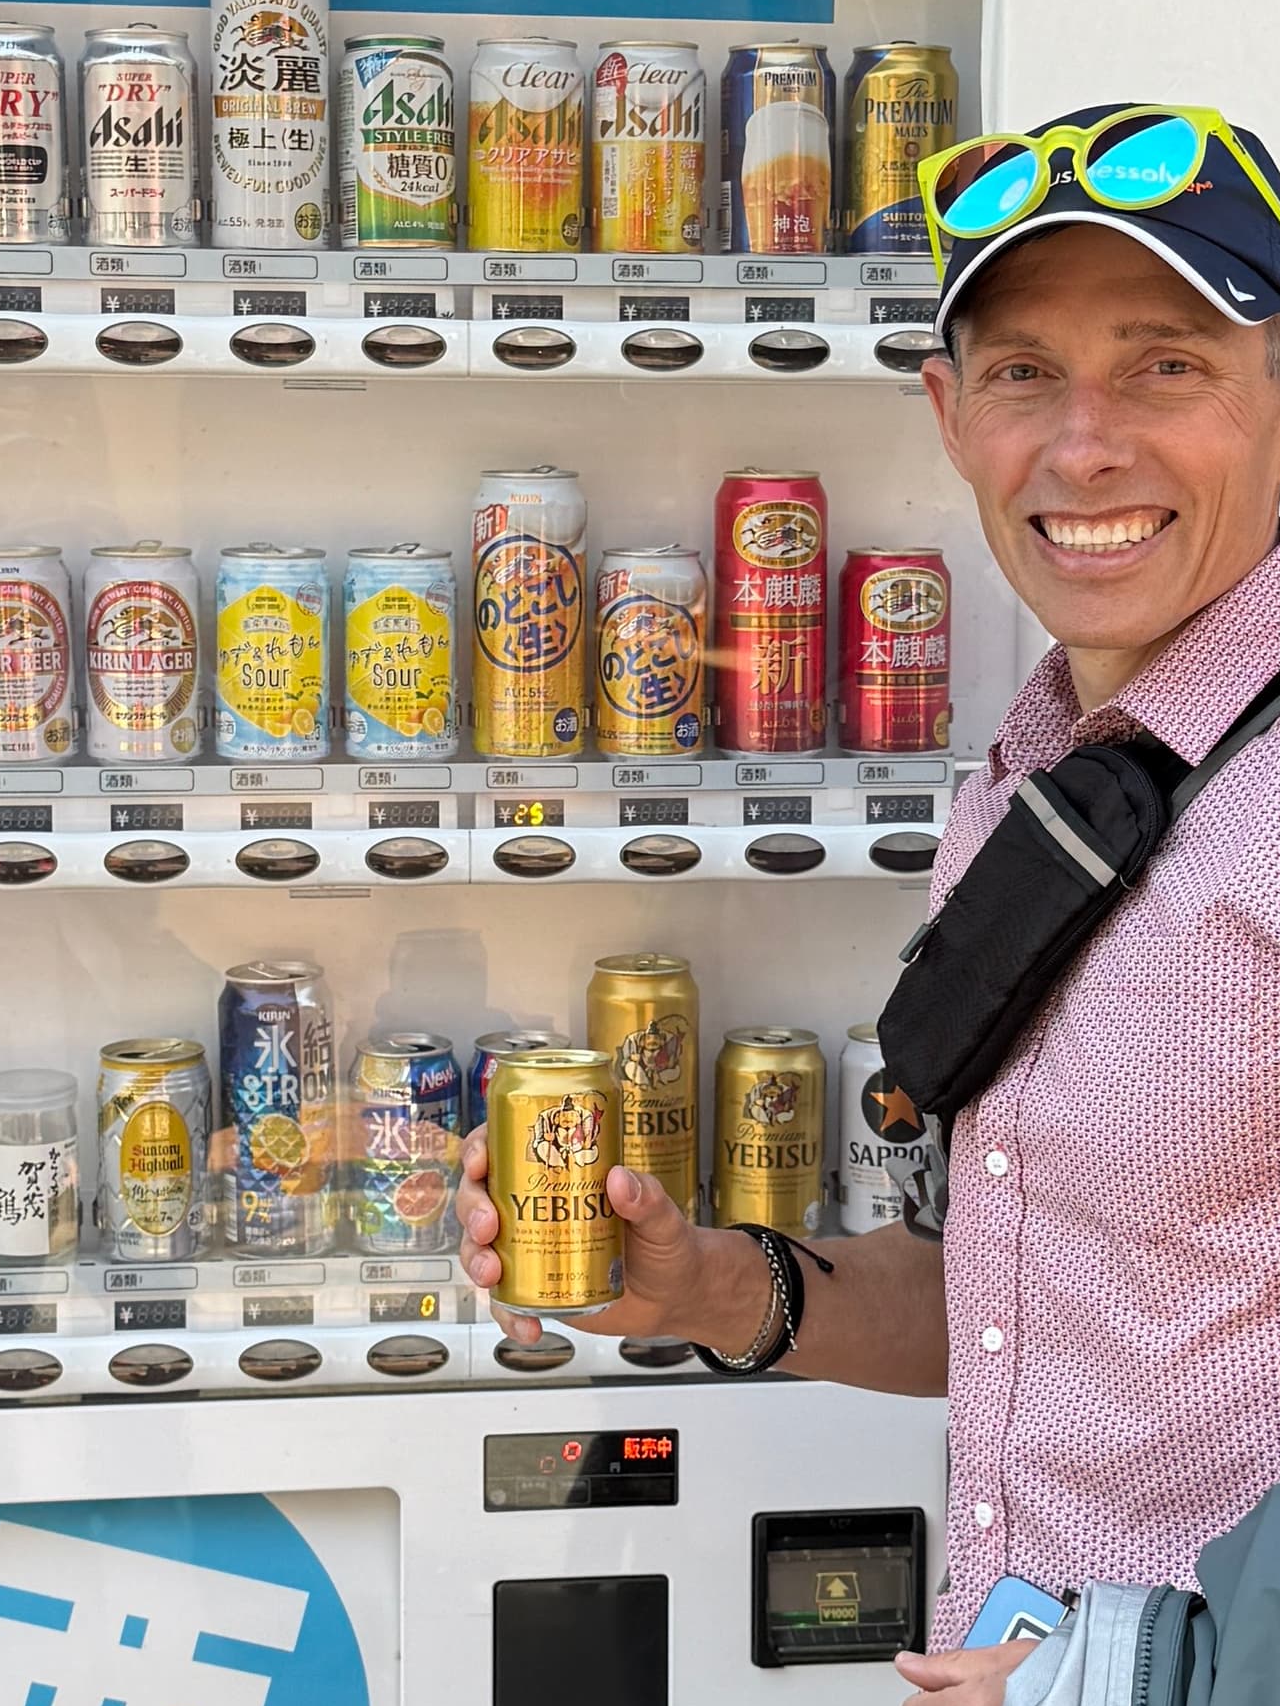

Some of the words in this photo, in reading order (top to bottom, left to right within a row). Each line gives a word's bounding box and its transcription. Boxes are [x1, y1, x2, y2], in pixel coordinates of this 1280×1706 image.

[218, 52, 321, 94] 淡麗
[502, 60, 575, 91] Clear
[626, 62, 689, 86] Clear
[763, 70, 818, 87] PREMIUM
[600, 92, 701, 140] Asahi
[863, 97, 953, 126] PREMIUM
[89, 105, 183, 149] Asahi
[374, 129, 423, 144] STYLE
[124, 155, 148, 173] 生
[478, 574, 579, 632] のどごし
[733, 572, 821, 609] 本麒麟
[20, 652, 62, 671] BEER
[89, 651, 136, 672] KIRIN
[136, 650, 194, 671] LAGER
[602, 629, 697, 684] のどごし
[750, 634, 809, 696] 新
[860, 634, 946, 670] 本麒麟
[241, 663, 293, 689] Sour
[372, 663, 422, 689] Sour
[555, 716, 578, 733] お酒
[675, 722, 699, 739] お酒
[258, 1010, 292, 1022] KIRIN
[419, 1063, 456, 1093] New!
[736, 1123, 808, 1143] Premium
[128, 1154, 185, 1176] Highball
[723, 1140, 818, 1170] YEBISU
[510, 1192, 614, 1223] YEBISU
[624, 1436, 673, 1460] 販売中
